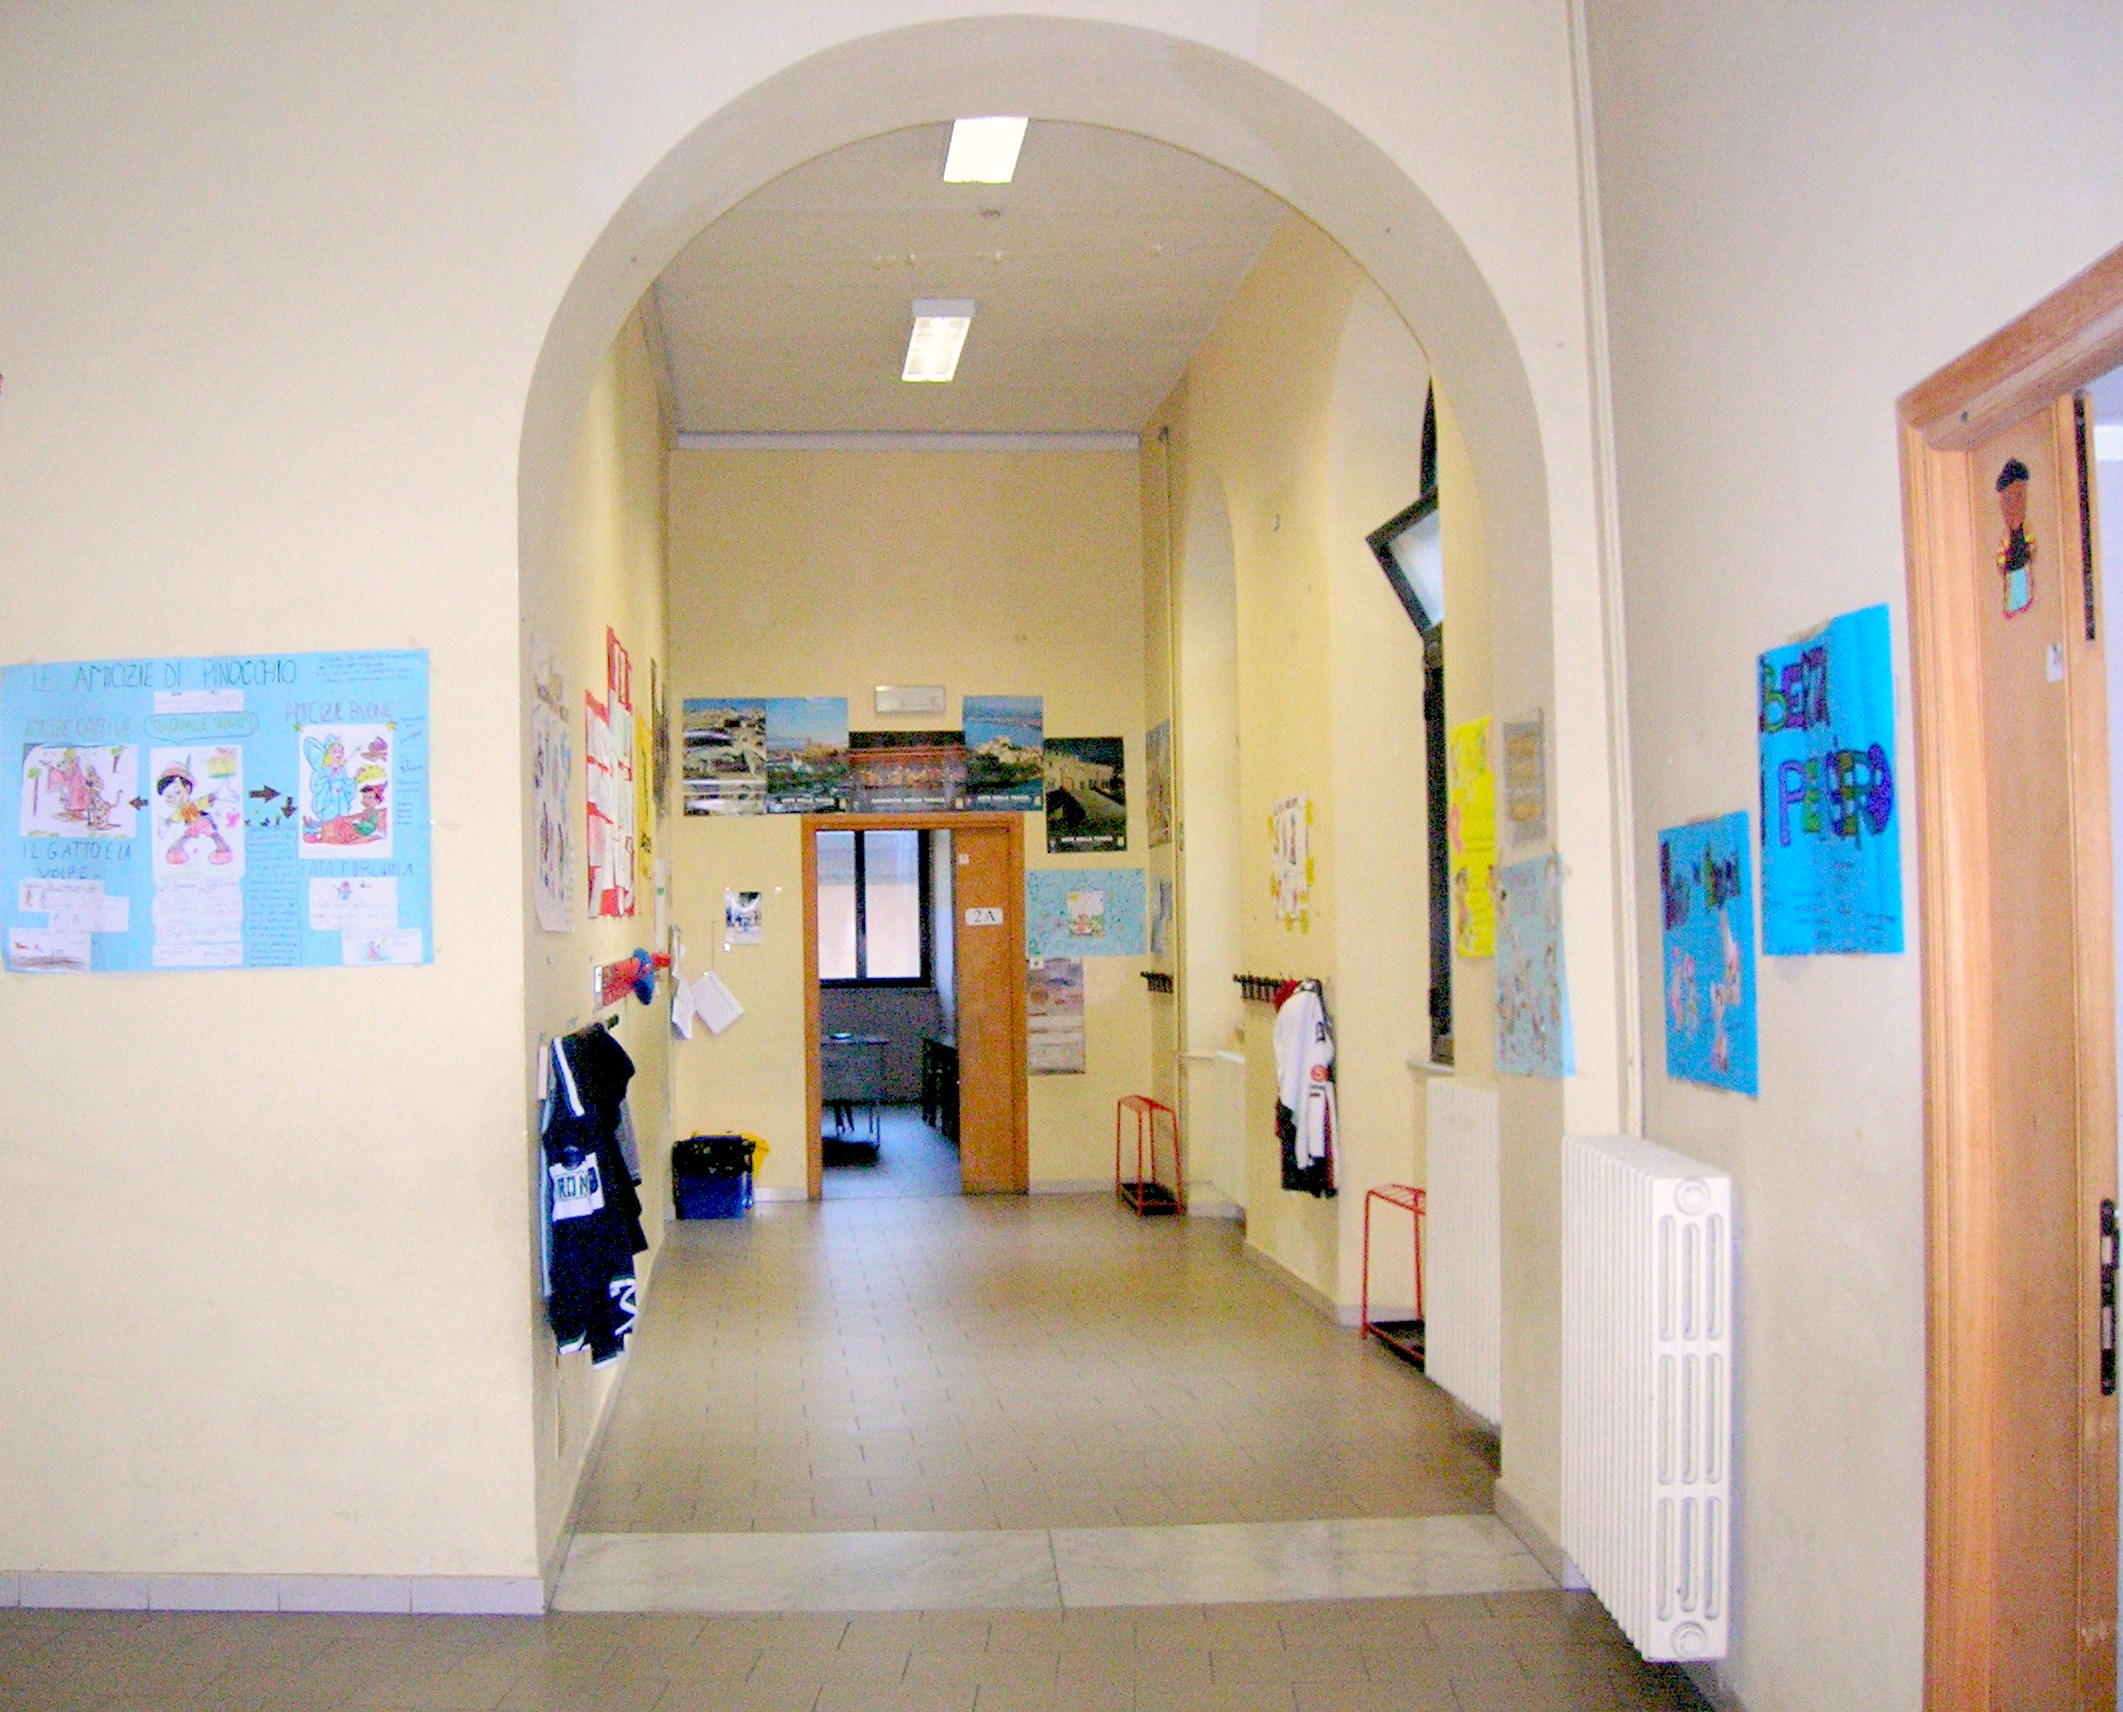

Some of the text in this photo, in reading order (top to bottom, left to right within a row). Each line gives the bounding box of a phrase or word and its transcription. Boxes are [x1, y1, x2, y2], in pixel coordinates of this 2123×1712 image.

[32, 663, 53, 692] LE
[163, 661, 182, 689] DI
[203, 658, 298, 687] PINOCCHIO
[22, 840, 132, 861] IL GATTO E LA
[36, 865, 89, 880] VOLPE
[973, 909, 996, 923] 2A
